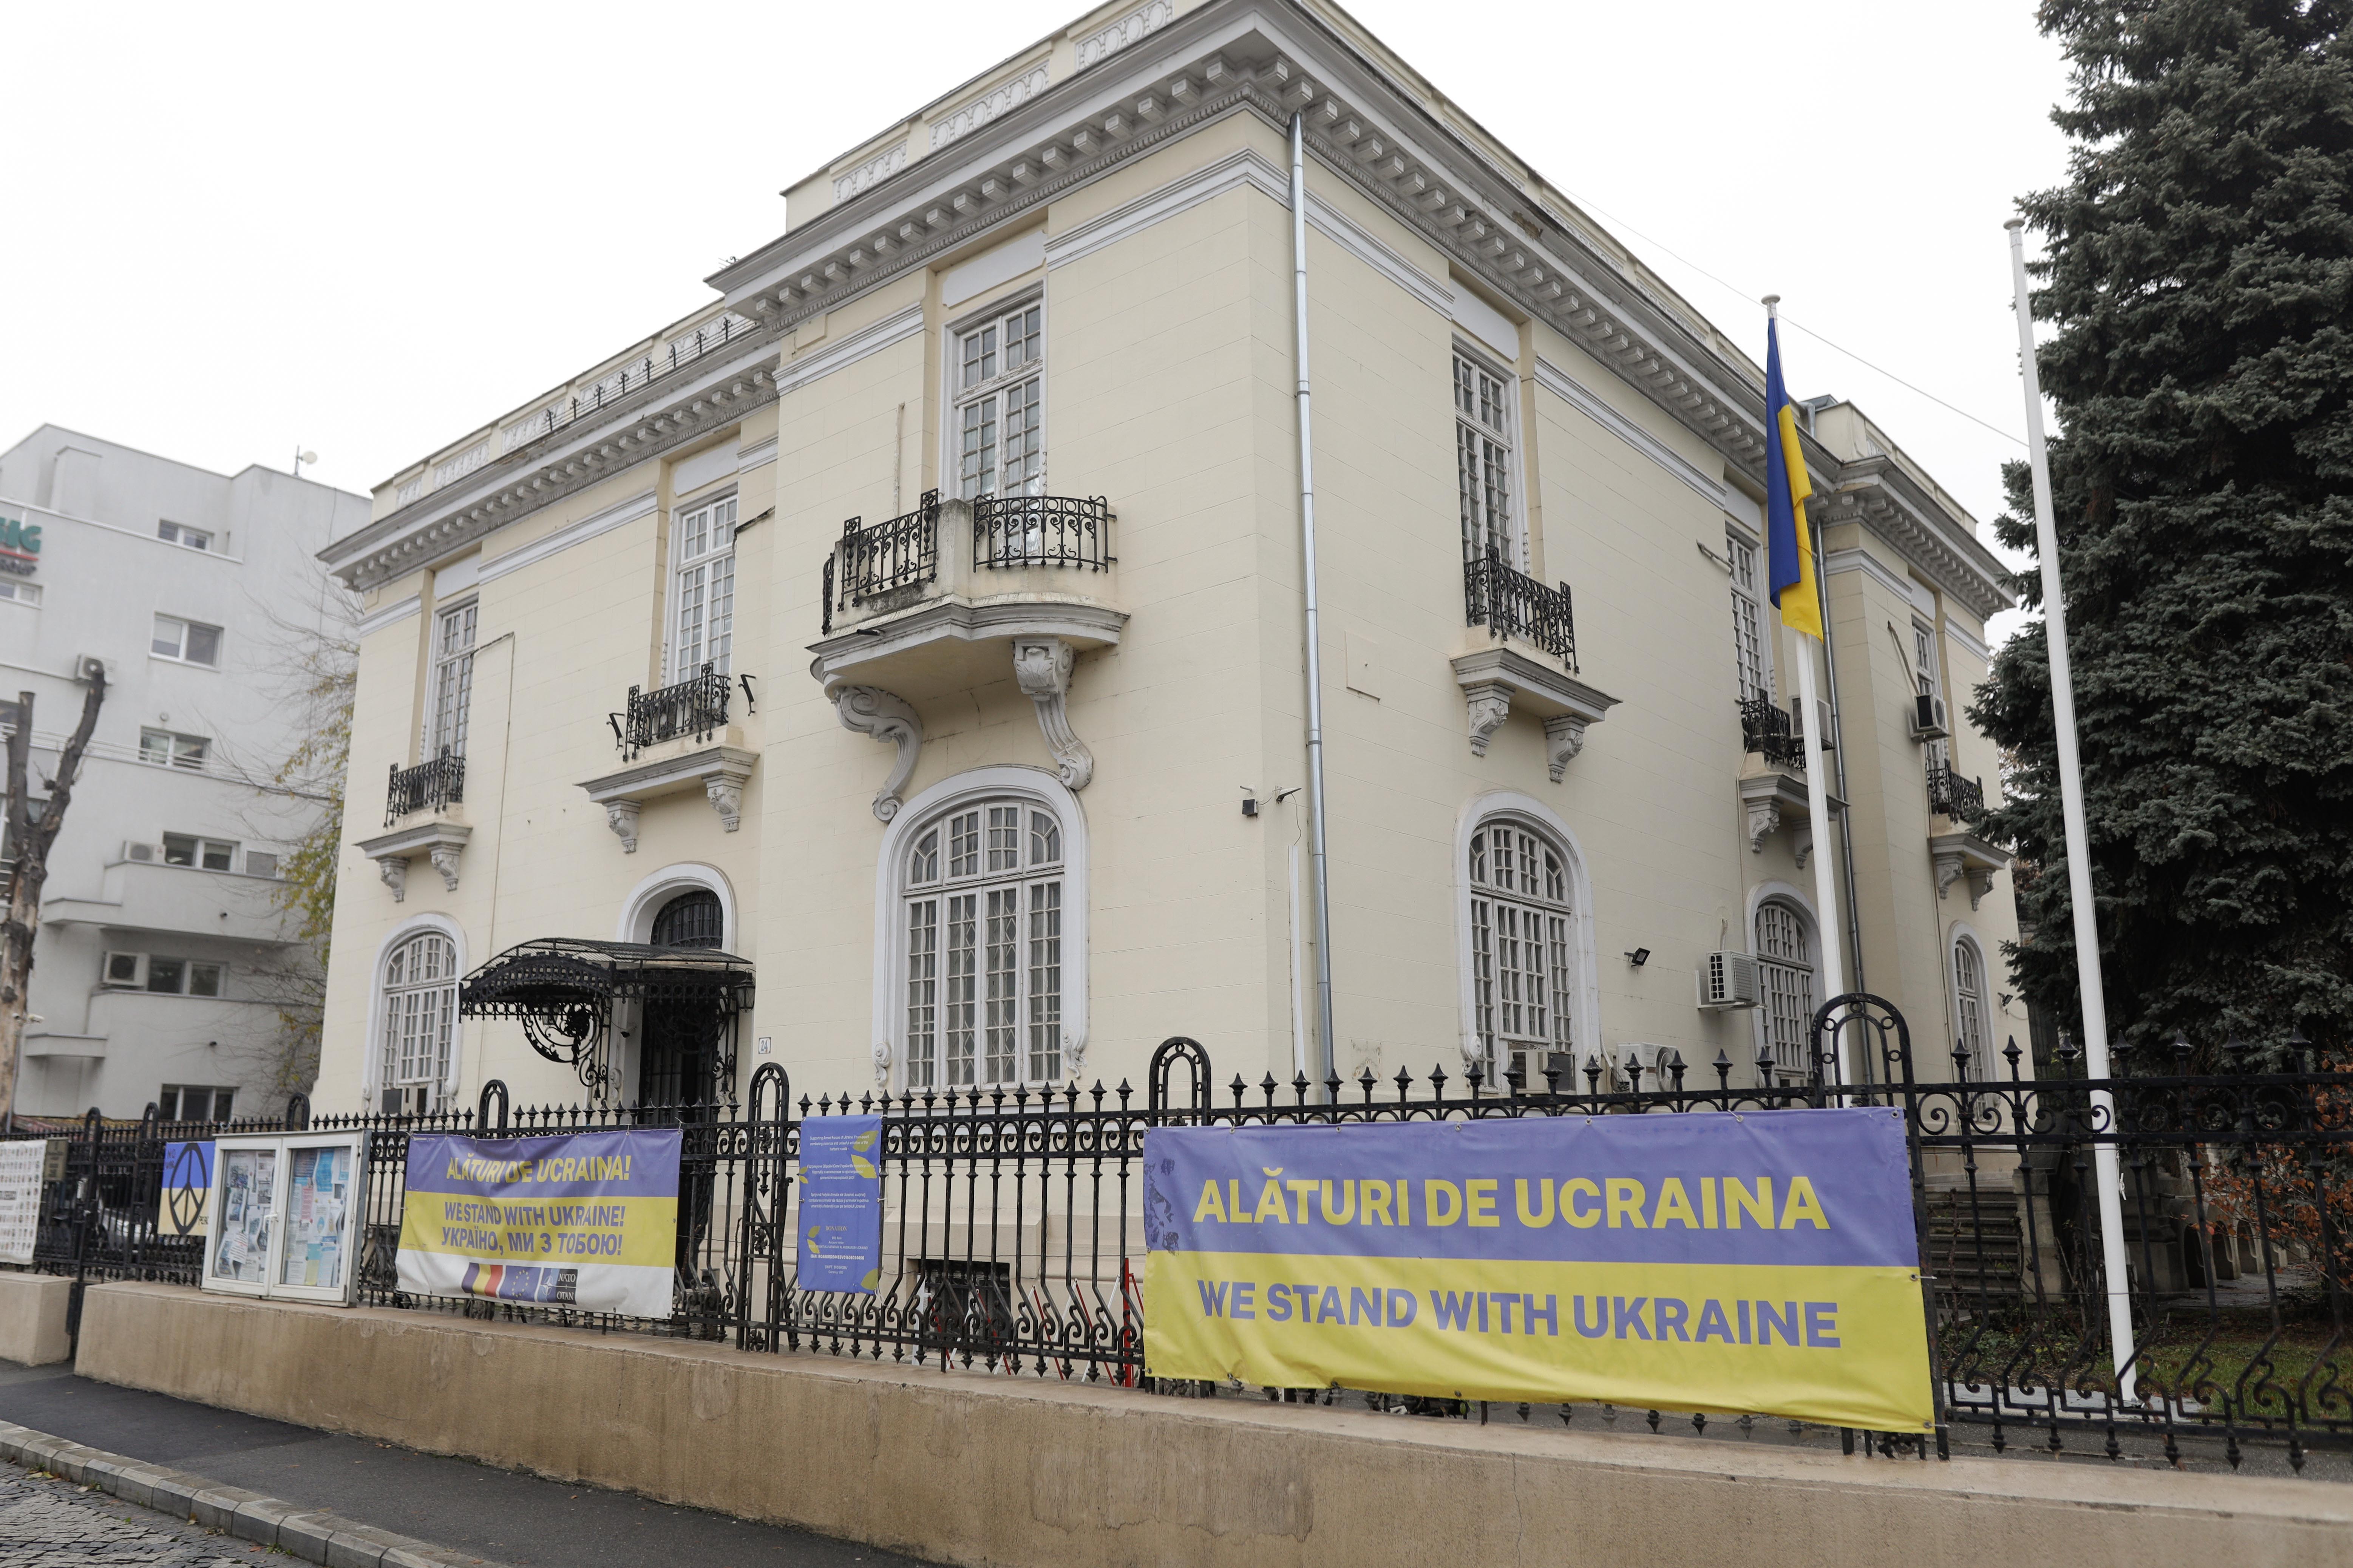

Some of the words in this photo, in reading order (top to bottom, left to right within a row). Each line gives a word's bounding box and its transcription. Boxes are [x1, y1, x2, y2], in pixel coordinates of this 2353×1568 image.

[761, 1039, 768, 1052] 24
[446, 1153, 501, 1183] ALĂTURI
[505, 1161, 533, 1183] DE
[537, 1155, 631, 1182] UCRAINA!
[1193, 1167, 1410, 1226] ALĂTURI
[1425, 1179, 1500, 1227] DE
[1515, 1176, 1831, 1230] UCRAINA
[445, 1201, 462, 1221] WE
[464, 1204, 502, 1226] STAND
[504, 1206, 544, 1226] WITH
[549, 1206, 626, 1227] UKRAINE!
[442, 1226, 504, 1255] УКРАЇНО,
[508, 1232, 534, 1252] МИ
[558, 1233, 622, 1256] ТОБОЮ!
[558, 1273, 576, 1282] NATO
[556, 1291, 574, 1301] OTAN
[1197, 1281, 1255, 1319] WE
[1267, 1284, 1418, 1327] STAND
[1430, 1290, 1558, 1336] WITH
[1573, 1296, 1841, 1348] UKRAINE
